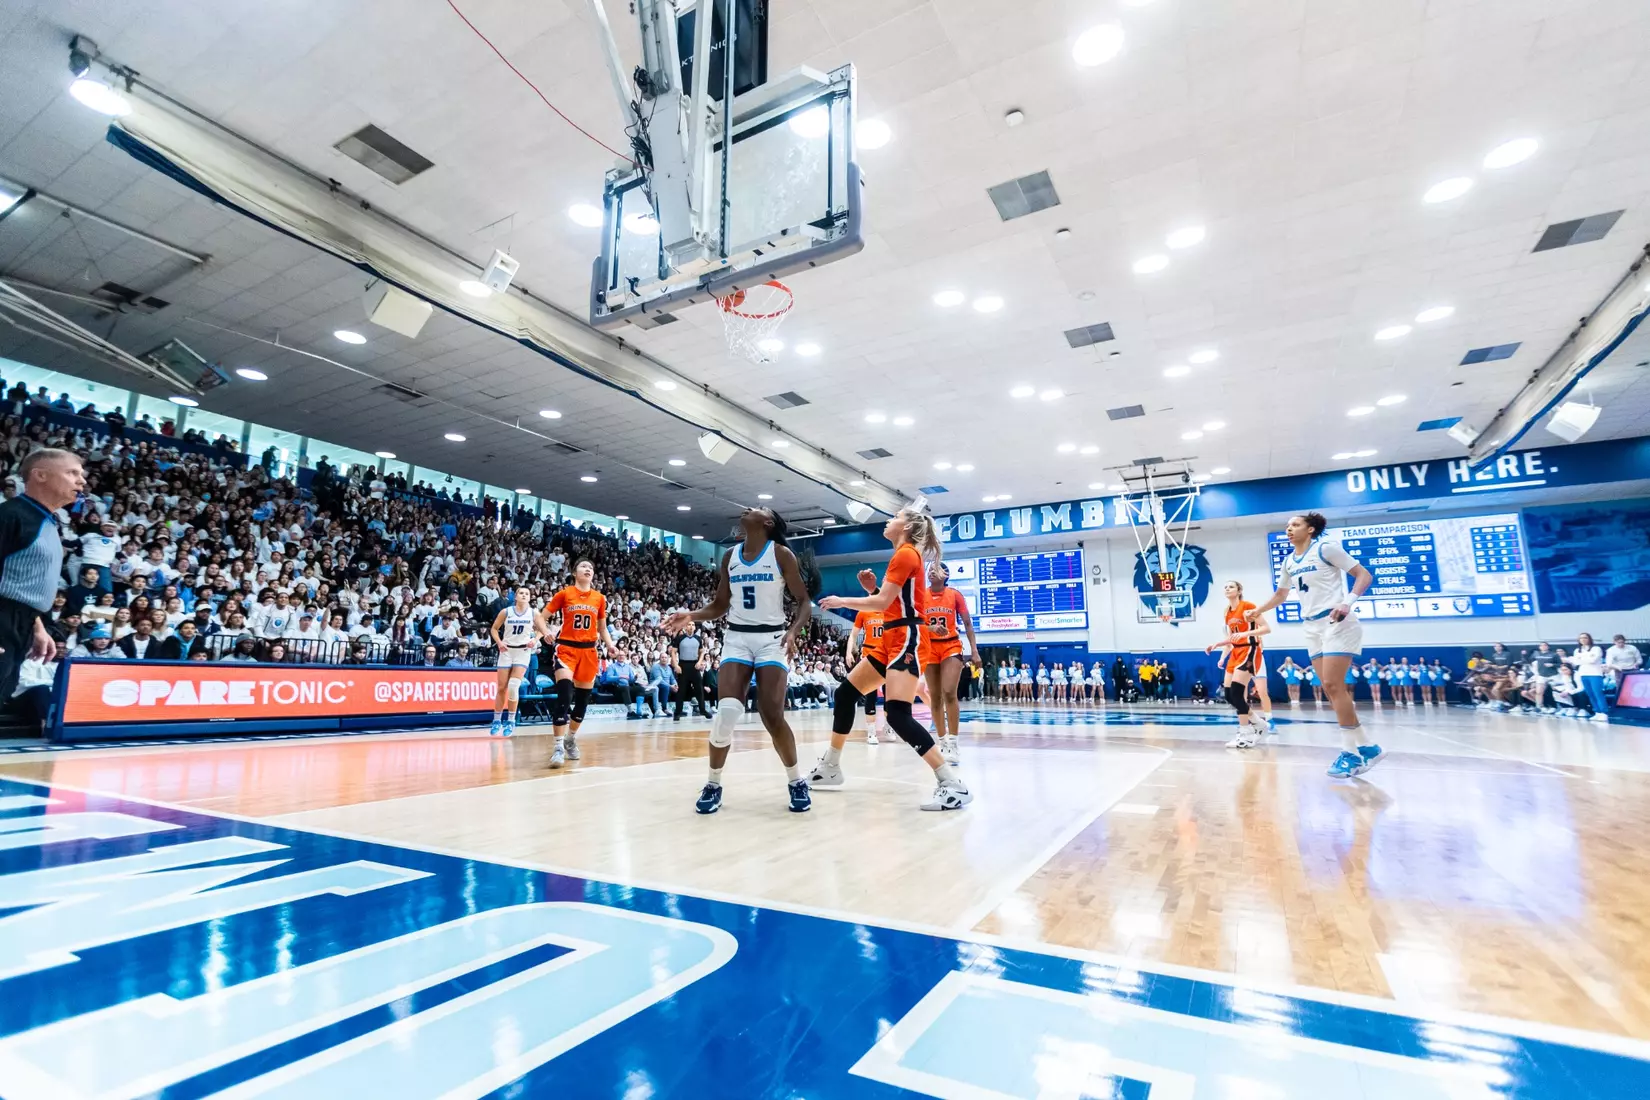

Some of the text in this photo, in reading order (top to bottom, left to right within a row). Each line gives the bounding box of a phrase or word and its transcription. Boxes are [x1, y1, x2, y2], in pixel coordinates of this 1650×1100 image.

[1346, 463, 1429, 493] ONLY
[935, 494, 1167, 542] COLUMBIA
[1342, 523, 1431, 537] TEAM COMPARISON
[1378, 537, 1395, 545] FG%
[1377, 547, 1399, 555] 3FG%
[1369, 556, 1410, 565] REBOUNDS
[1375, 566, 1407, 575] ASSISTS
[1298, 576, 1309, 592] 4
[1378, 576, 1406, 584] STEALS
[1371, 586, 1416, 595] TURNOVERS
[742, 586, 756, 610] 5
[1432, 603, 1439, 611] 3
[573, 614, 592, 630] 20
[930, 616, 947, 628] 23
[512, 625, 524, 635] 10
[873, 626, 883, 638] 10
[101, 679, 256, 707] SPARE
[374, 680, 497, 703] @SPAREFOODCO
